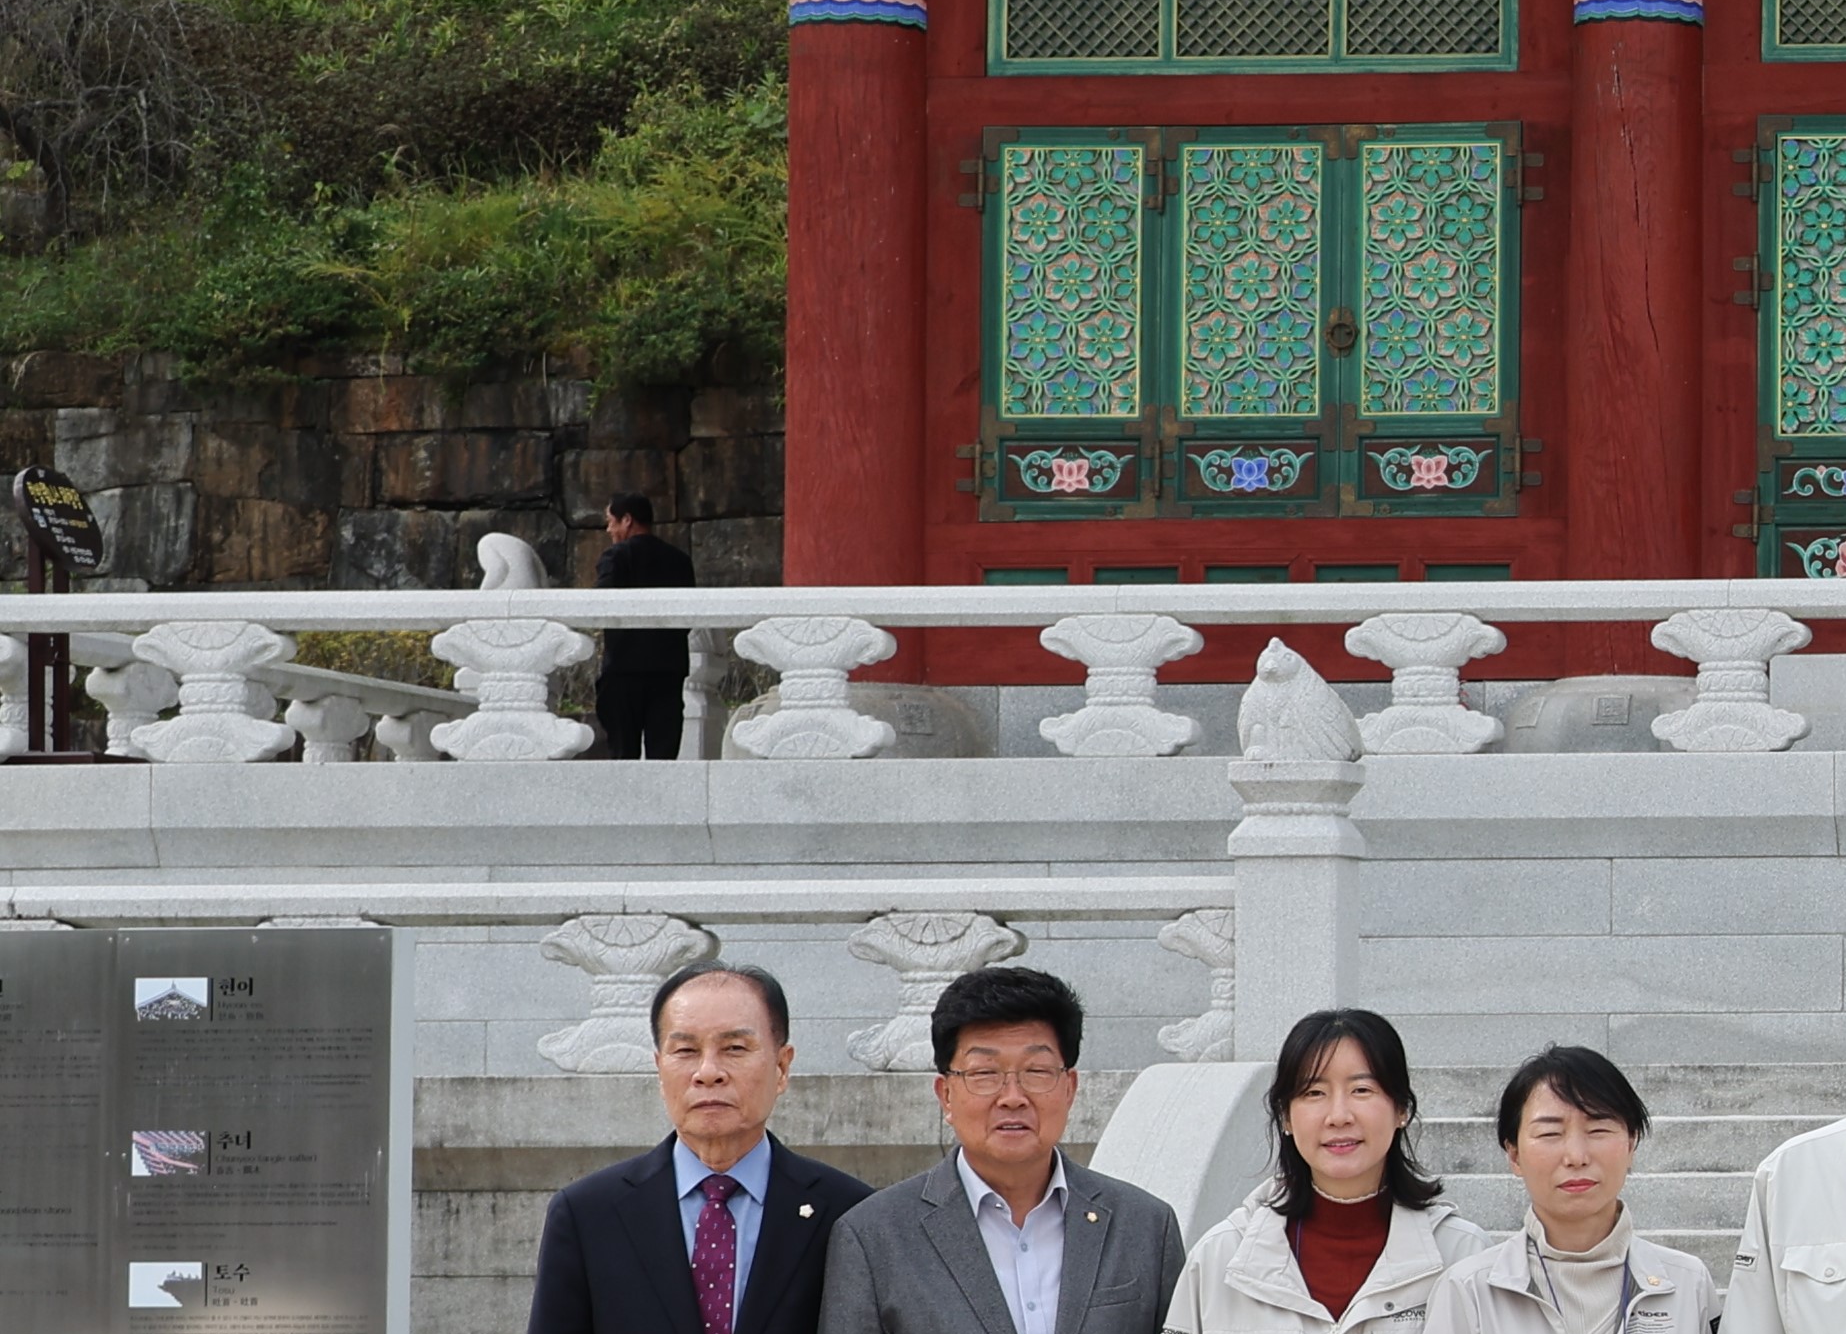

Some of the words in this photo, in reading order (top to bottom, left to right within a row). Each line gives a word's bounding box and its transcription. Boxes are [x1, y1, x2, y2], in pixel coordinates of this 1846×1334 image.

[217, 977, 255, 997] 현어
[216, 1130, 252, 1150] 추녀
[213, 1263, 251, 1283] 토수
